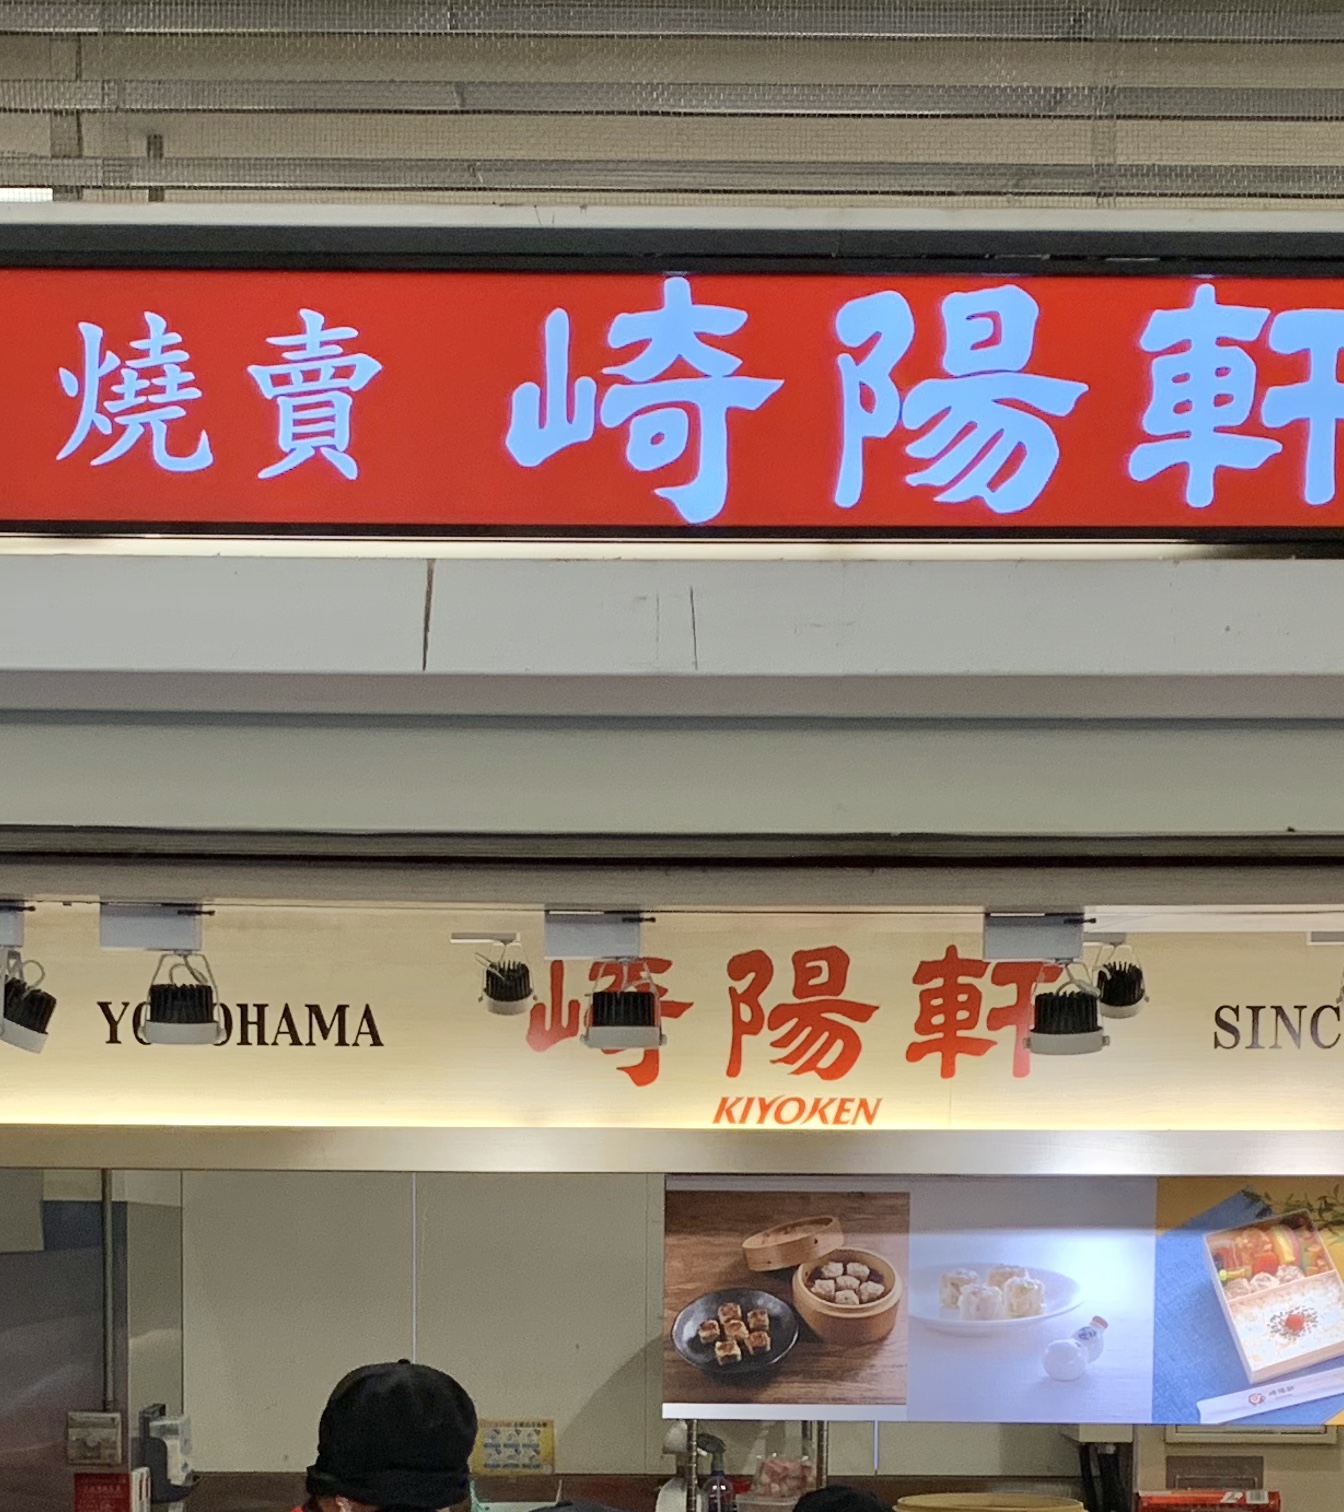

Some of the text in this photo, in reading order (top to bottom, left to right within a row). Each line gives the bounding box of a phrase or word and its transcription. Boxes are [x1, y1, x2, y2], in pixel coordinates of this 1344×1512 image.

[57, 309, 383, 482] 燒賣
[96, 1001, 384, 1047] YHAMA
[712, 1095, 884, 1126] KIYOKEN
